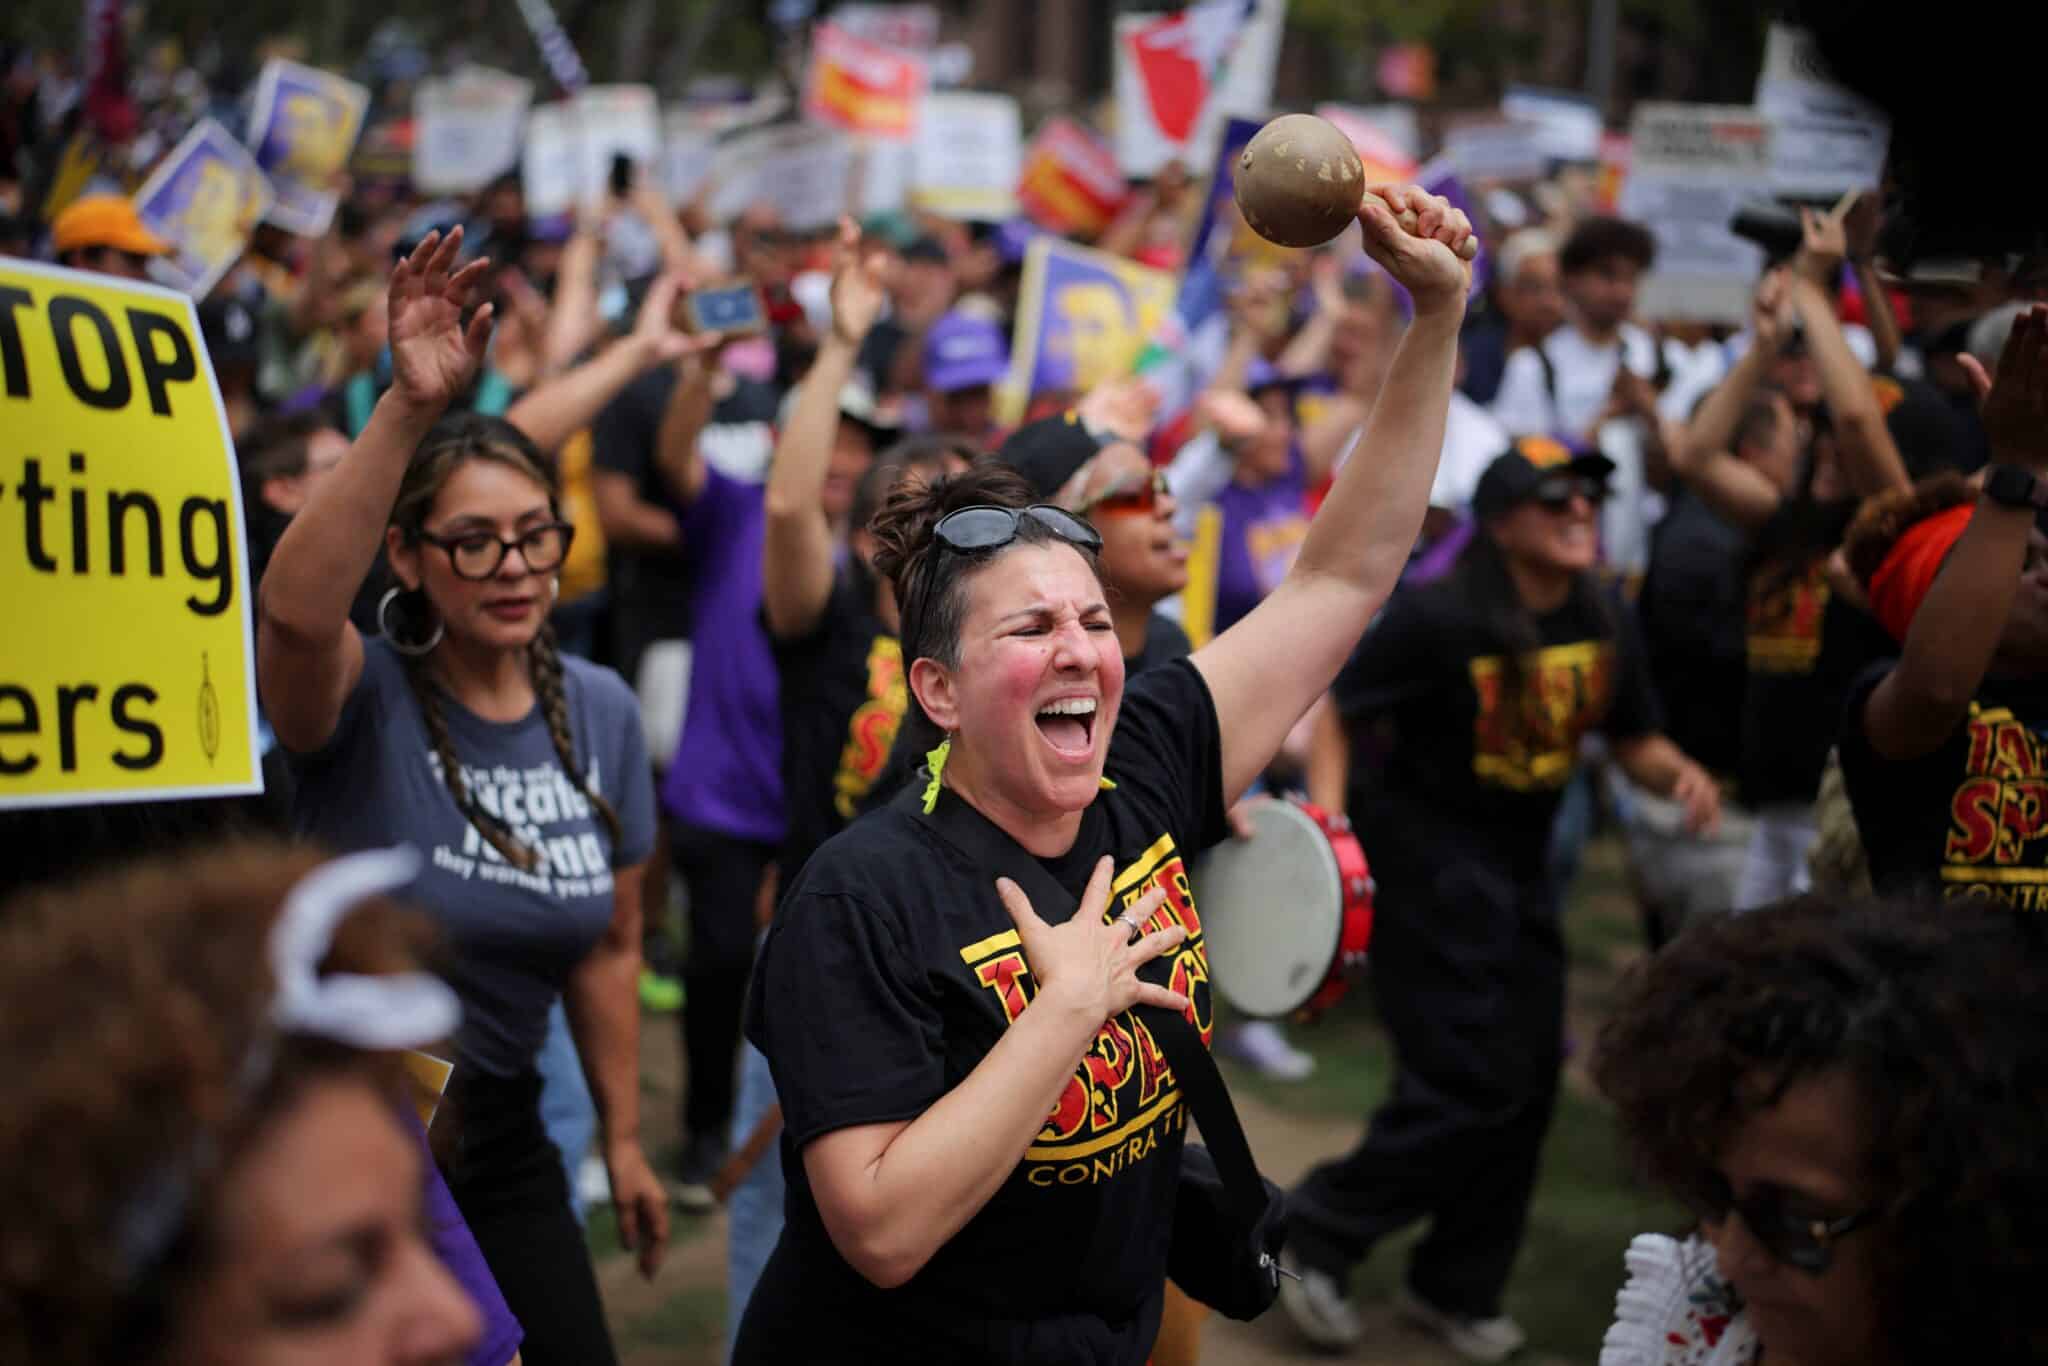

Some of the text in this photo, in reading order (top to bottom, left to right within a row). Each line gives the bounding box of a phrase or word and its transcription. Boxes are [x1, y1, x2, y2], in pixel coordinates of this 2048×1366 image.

[0, 282, 197, 418] TOP
[0, 452, 233, 617] ting
[1028, 1127, 1158, 1187] CONTRA
